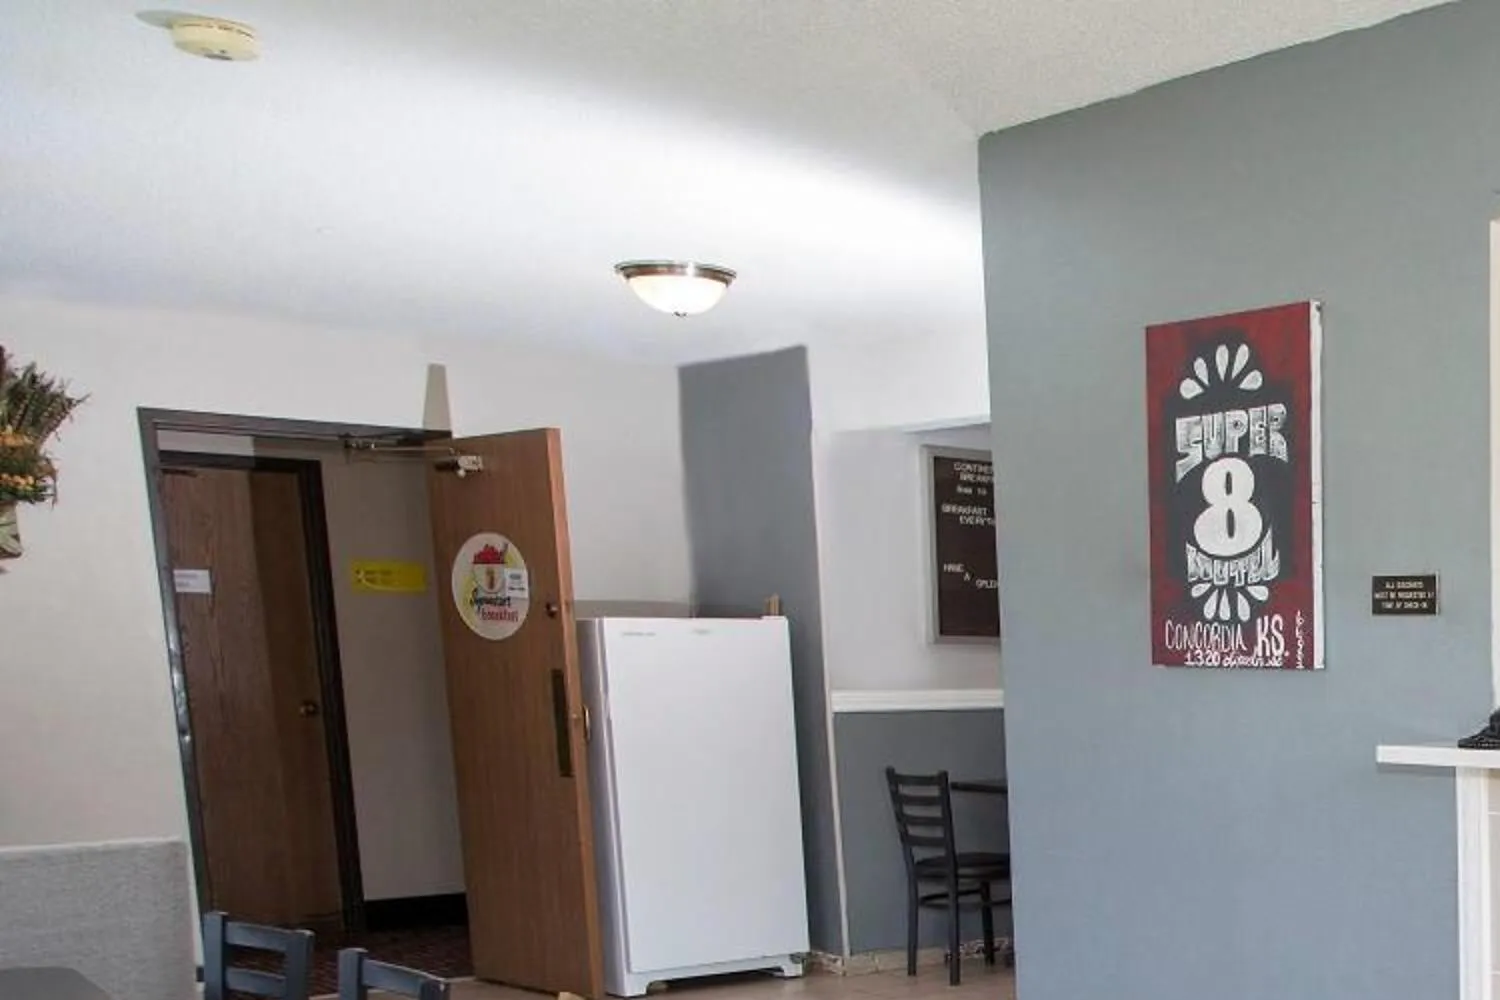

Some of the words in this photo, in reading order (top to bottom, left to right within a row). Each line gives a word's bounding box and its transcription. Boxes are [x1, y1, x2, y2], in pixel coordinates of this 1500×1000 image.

[1175, 403, 1288, 484] SUPER
[1193, 456, 1263, 557] 8
[1165, 619, 1248, 652] CONCORDIA
[1184, 650, 1221, 667] 1320
